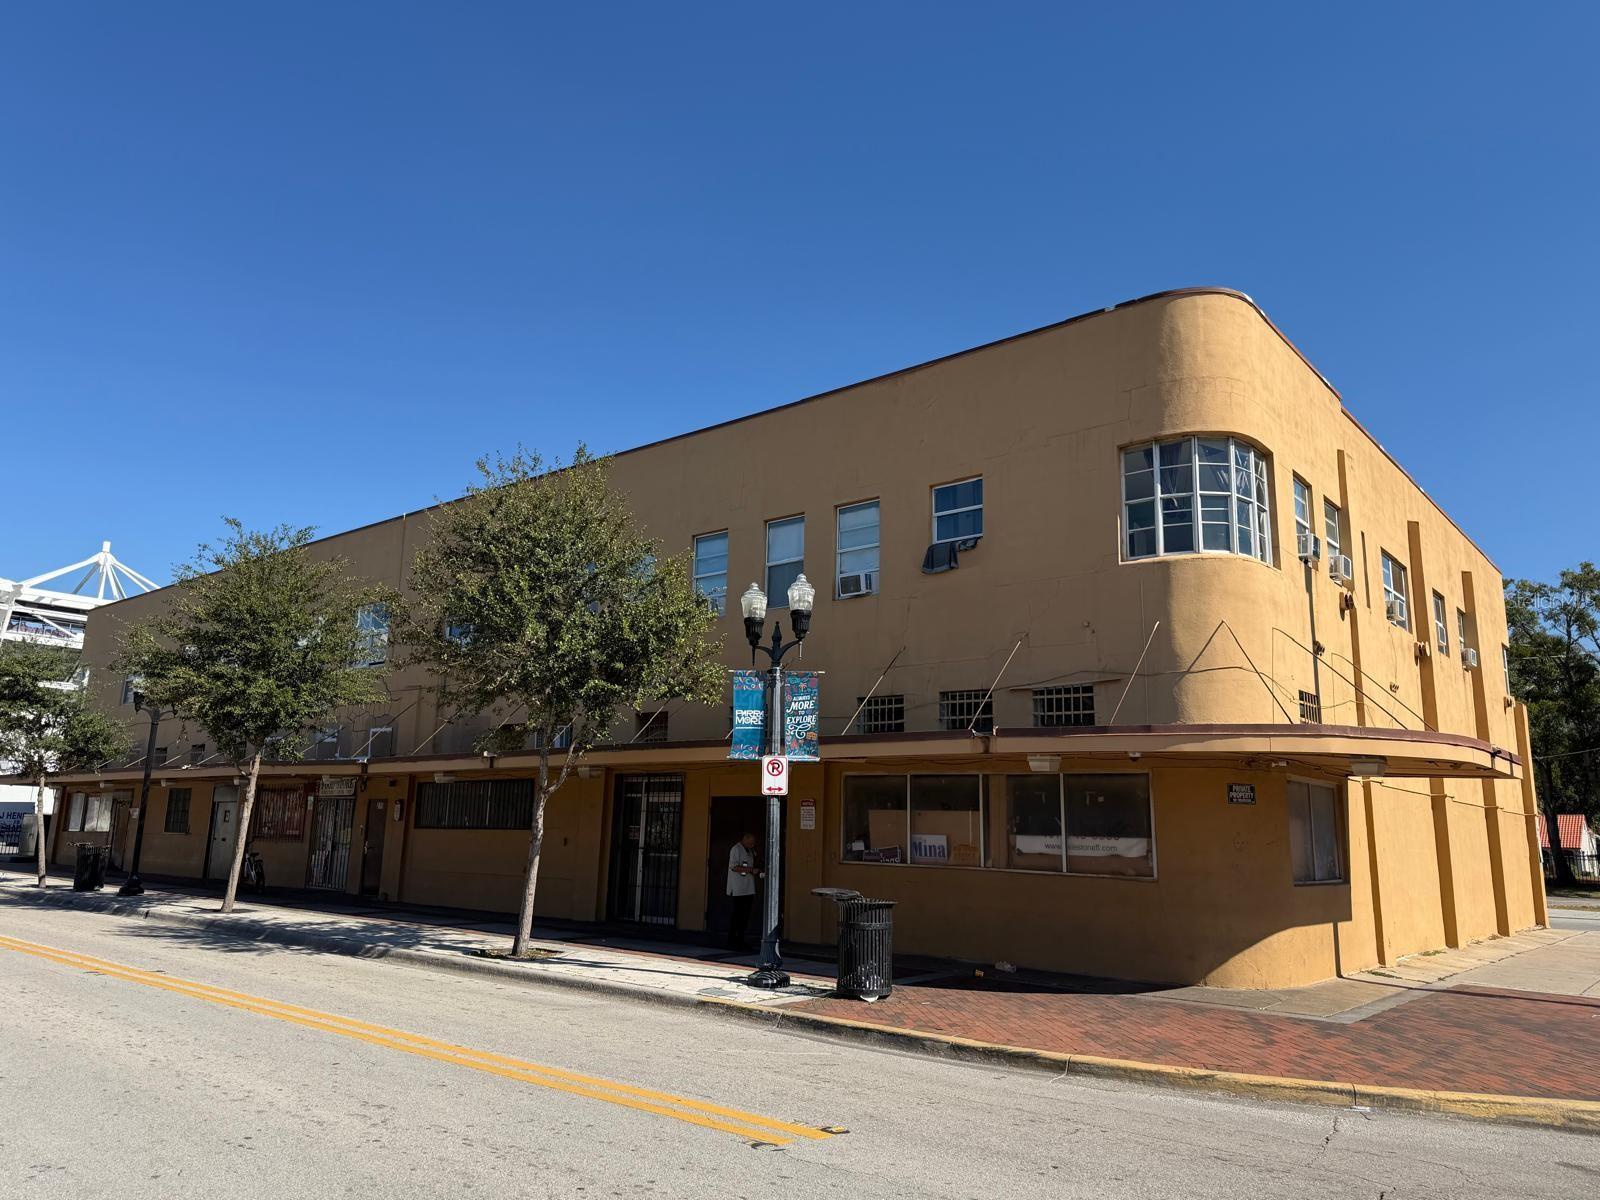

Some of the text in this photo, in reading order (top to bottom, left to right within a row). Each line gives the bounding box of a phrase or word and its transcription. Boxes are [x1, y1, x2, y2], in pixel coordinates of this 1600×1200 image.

[786, 700, 815, 713] MORE
[735, 709, 765, 717] PARRA
[735, 716, 765, 725] MORE
[786, 714, 817, 724] EXPLORE
[912, 840, 946, 858] Mina
